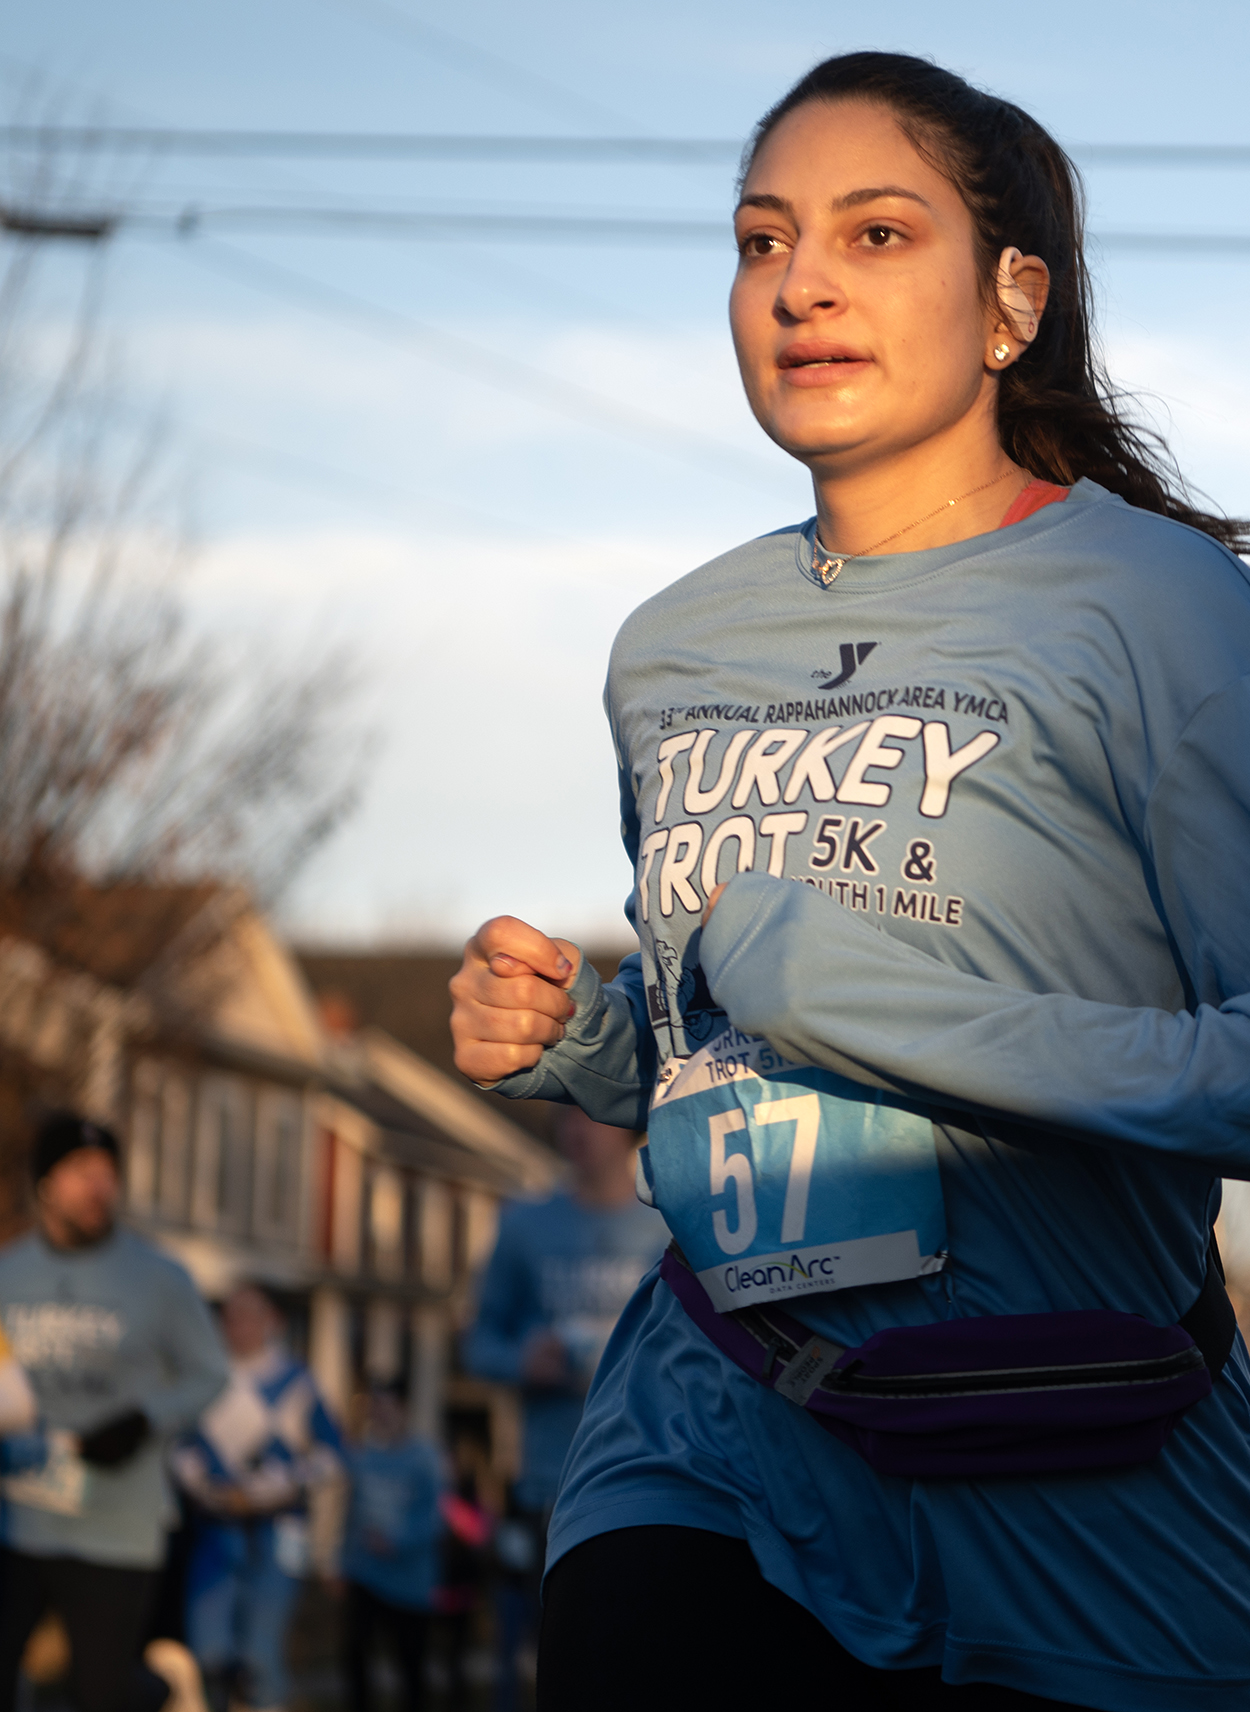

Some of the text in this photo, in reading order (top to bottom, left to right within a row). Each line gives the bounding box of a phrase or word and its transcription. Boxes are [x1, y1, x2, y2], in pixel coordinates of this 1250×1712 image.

[685, 704, 760, 723] ANNUAL
[763, 688, 899, 724] RAPPAHANNOCK
[898, 686, 946, 710] AREA
[952, 691, 1009, 725] YMCA
[654, 714, 1001, 823] TURKEY
[641, 811, 936, 924] TROT 5K &
[876, 886, 887, 913] 1
[892, 888, 963, 926] MILE
[705, 1052, 750, 1083] TROT
[708, 1093, 820, 1256] 57
[769, 1279, 836, 1294] DATA CENTERS
